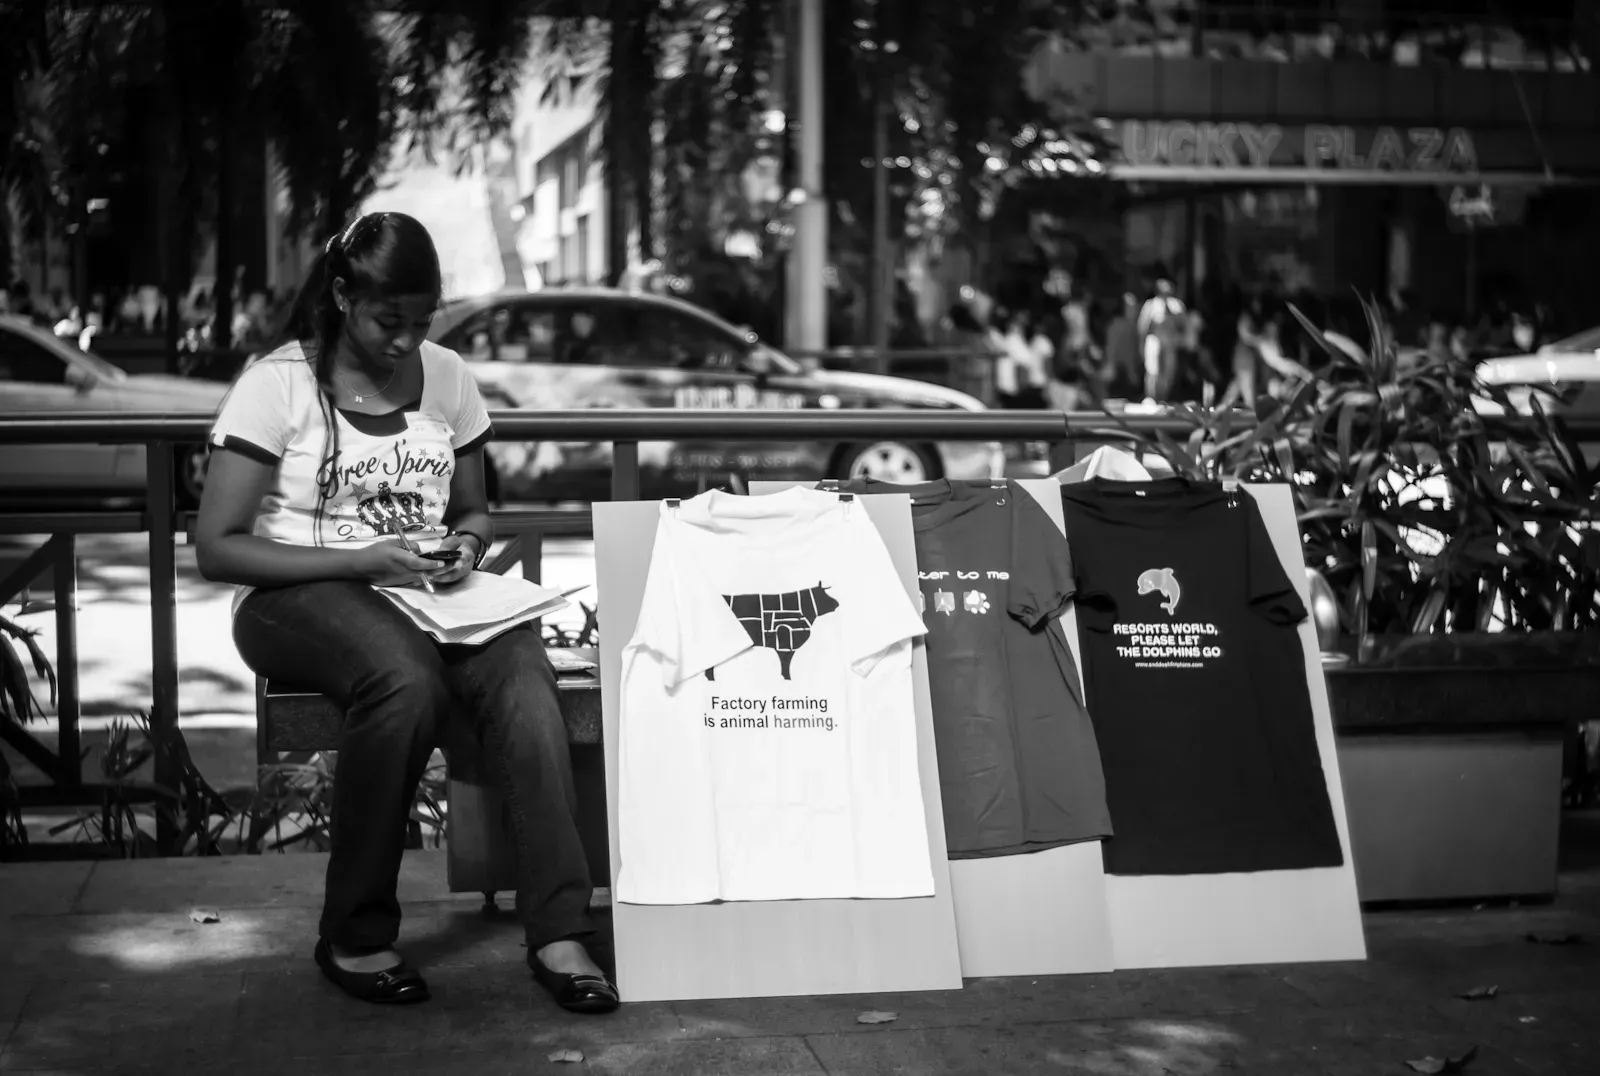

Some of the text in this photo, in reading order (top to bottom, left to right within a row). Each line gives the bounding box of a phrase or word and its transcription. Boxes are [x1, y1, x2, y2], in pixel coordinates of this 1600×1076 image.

[1120, 119, 1479, 174] UCKY PLAZA
[316, 439, 451, 499] Free Spirit
[957, 570, 980, 580] to
[986, 571, 1010, 580] me
[1113, 623, 1219, 636] RESORTS WORLD,
[1131, 635, 1200, 646] PLEASE LET
[1116, 646, 1221, 658] THE DOLPHINS GO
[711, 695, 828, 713] Factory farming
[704, 713, 838, 731] is animal harming.
